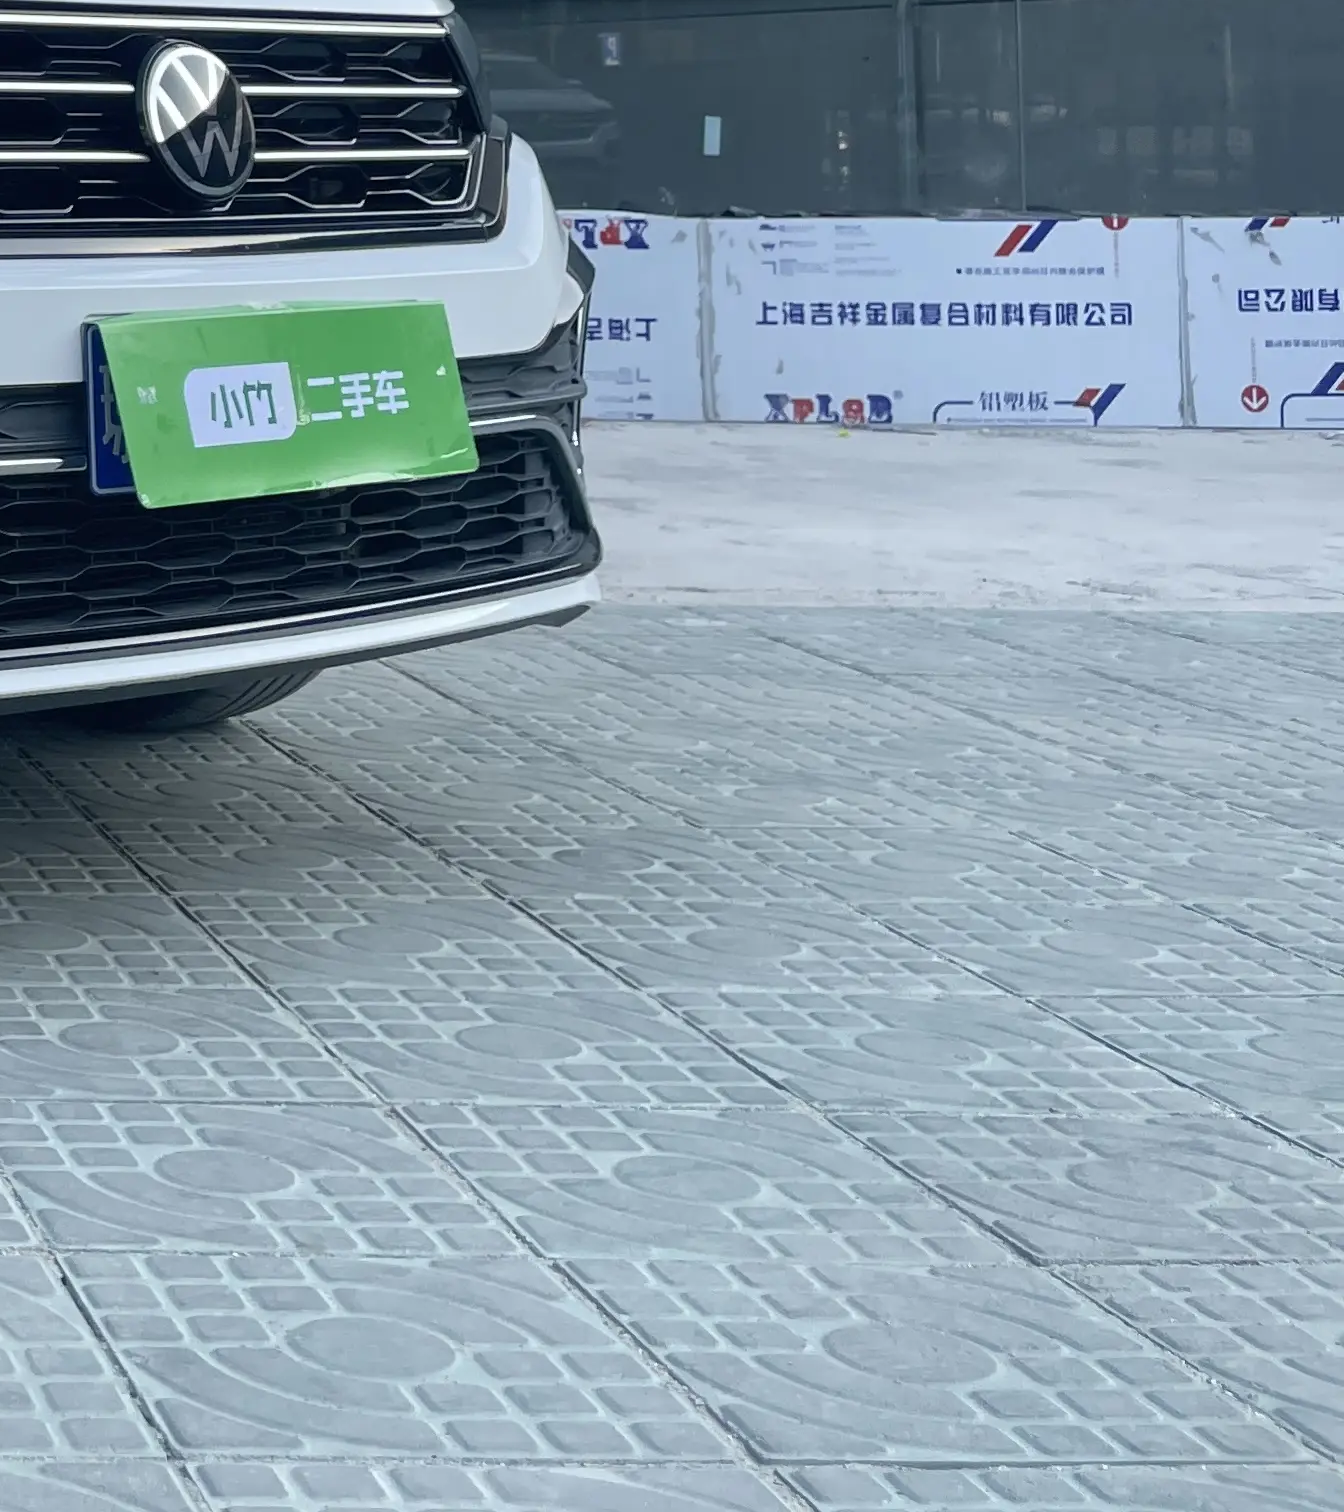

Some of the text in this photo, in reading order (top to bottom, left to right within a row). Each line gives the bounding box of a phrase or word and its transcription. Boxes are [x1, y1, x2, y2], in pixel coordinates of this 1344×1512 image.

[1238, 288, 1340, 313] 有限公司
[755, 301, 1134, 327] 上海吉祥金属复合材料有限公司
[307, 370, 410, 420] 二手车
[978, 390, 1050, 412] 铝塑板
